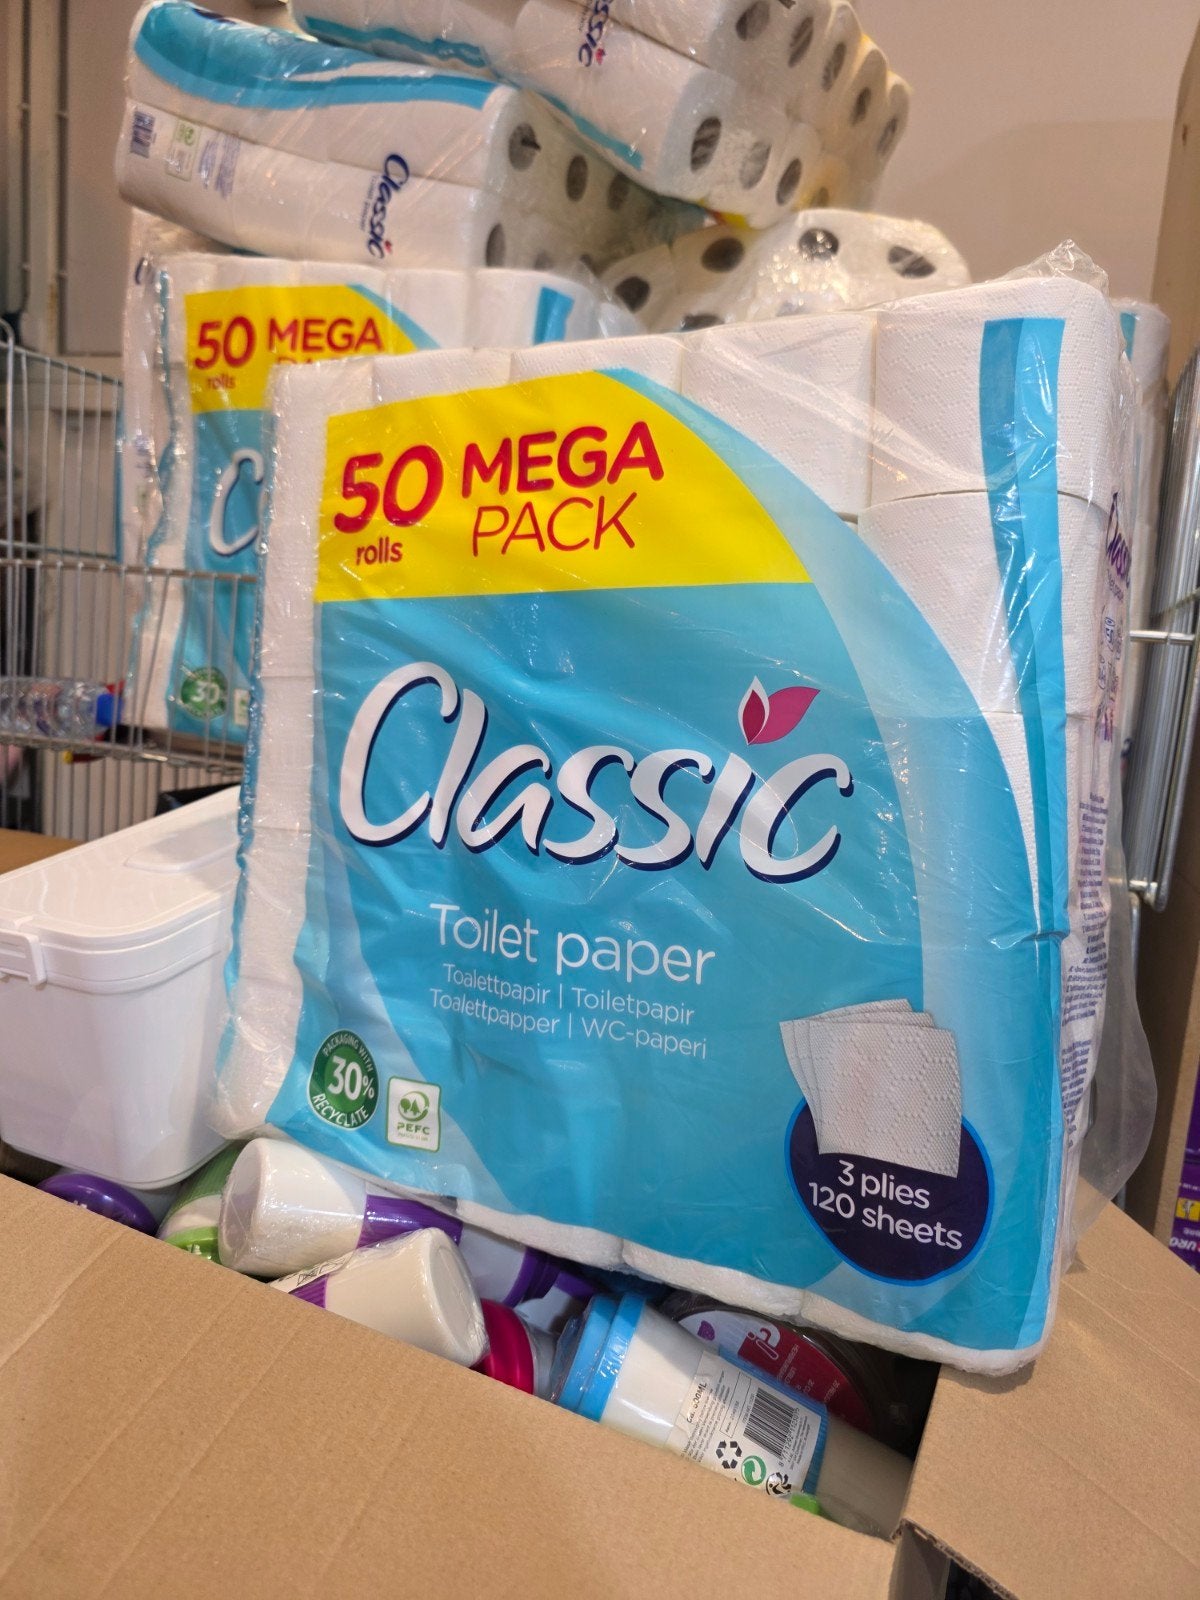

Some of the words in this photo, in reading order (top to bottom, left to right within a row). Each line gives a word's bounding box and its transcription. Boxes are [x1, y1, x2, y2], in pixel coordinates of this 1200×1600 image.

[578, 0, 612, 67] ssic
[368, 154, 410, 259] Classic
[194, 315, 257, 370] 50
[268, 316, 385, 352] MEGA
[206, 373, 236, 390] rolls
[332, 444, 444, 534] 50
[460, 420, 665, 499] MEGA
[355, 537, 403, 566] rolls
[472, 491, 638, 557] PACK
[339, 661, 855, 884] Classic
[429, 903, 539, 963] Toilet
[556, 931, 716, 985] paper
[429, 988, 560, 1034] Toalettpapper
[581, 1016, 707, 1060] WC-paperi
[442, 963, 551, 1005] Toalettpapir
[571, 987, 695, 1026] Toiletpapir
[322, 1033, 360, 1057] PACKAGING
[358, 1044, 374, 1073] WITH
[327, 1055, 375, 1101] 30%
[311, 1092, 369, 1128] RECYCLATE
[397, 1122, 431, 1136] PEFC
[837, 1158, 855, 1187] 3
[860, 1172, 931, 1210] plies
[808, 1182, 856, 1219] 120
[861, 1204, 963, 1250] sheets
